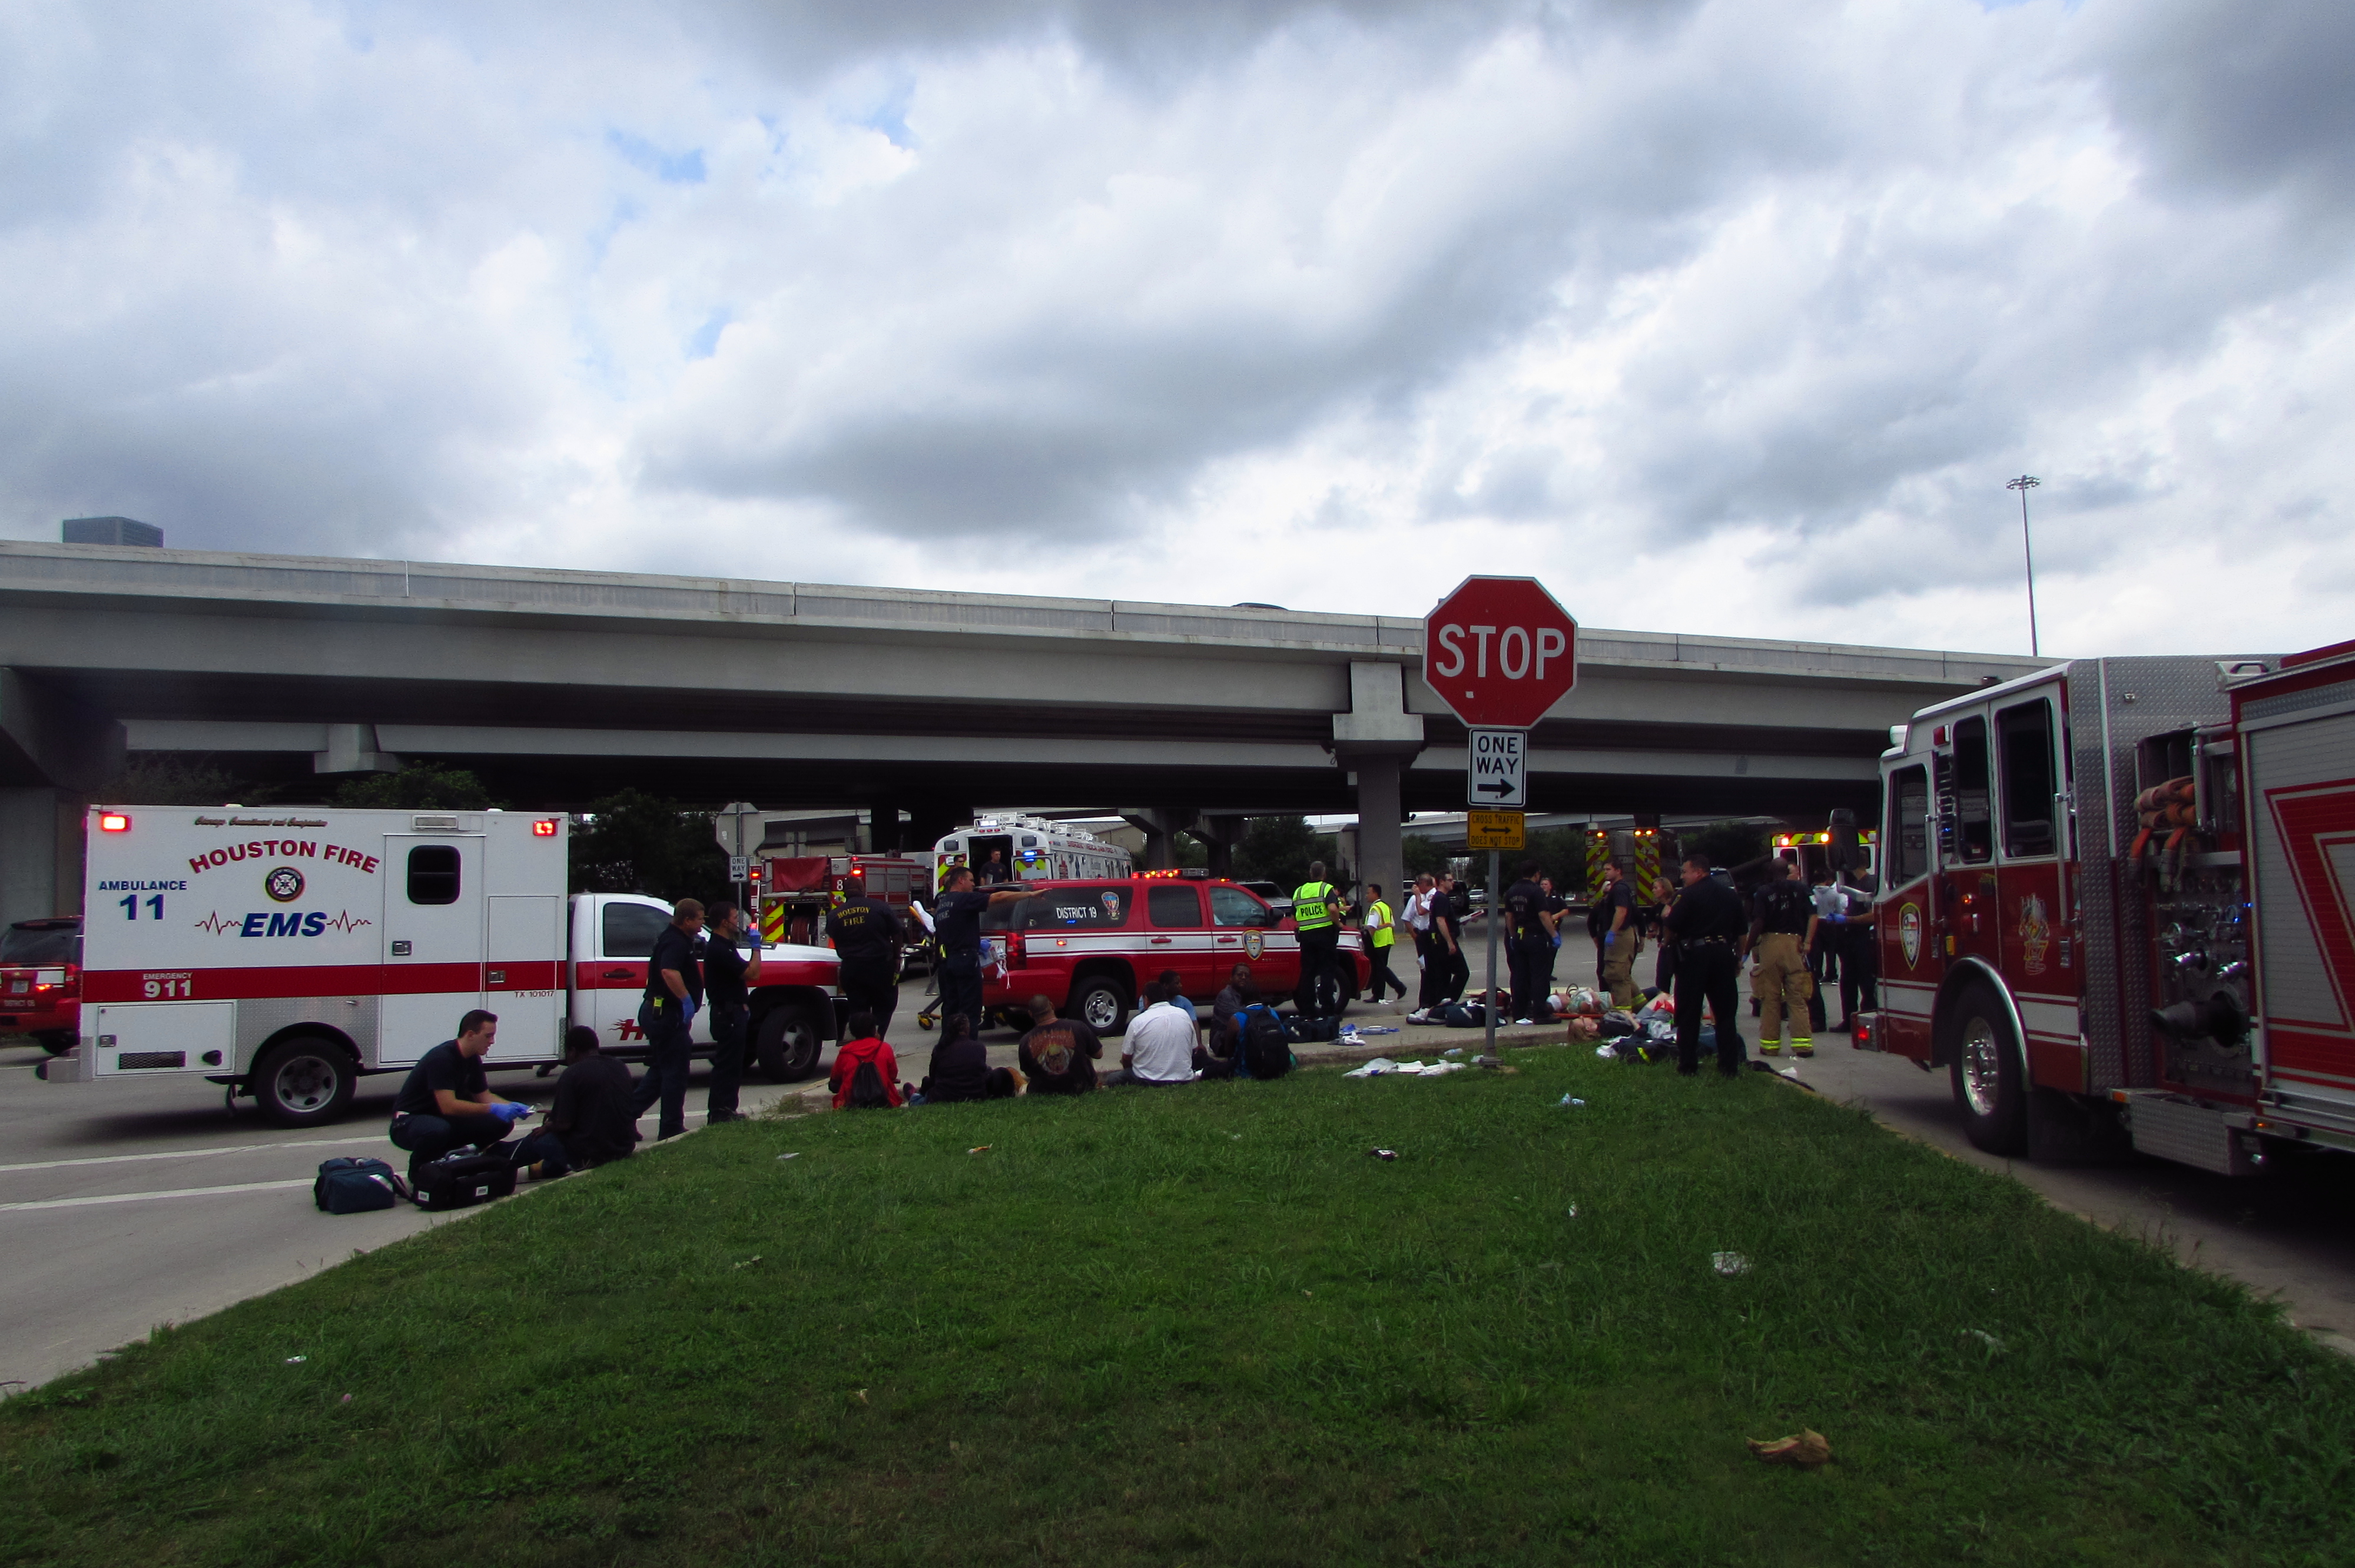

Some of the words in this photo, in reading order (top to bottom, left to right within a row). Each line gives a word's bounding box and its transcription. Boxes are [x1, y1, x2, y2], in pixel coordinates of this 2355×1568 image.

[1435, 623, 1565, 680] STOP
[1478, 735, 1518, 754] ONE
[1477, 756, 1518, 775] WAY
[1472, 815, 1492, 824] CROSS
[1495, 814, 1520, 825] TRAFFIC
[1471, 835, 1487, 845] DOES
[1489, 836, 1501, 846] NOT
[1504, 836, 1520, 846] STOP
[189, 840, 317, 873] HOUSTON
[324, 844, 380, 873] FIRE
[99, 881, 187, 891] AMBULANCE
[837, 879, 843, 891] 8
[120, 893, 165, 921] 11
[837, 906, 871, 919] HOUSTON
[1056, 907, 1087, 919] DISTRICT
[1089, 906, 1097, 918] 19
[1300, 905, 1323, 917] POLICE
[240, 912, 328, 938] EMS
[844, 915, 865, 927] FIRE
[143, 972, 193, 980] EMERGENCY
[144, 979, 192, 998] 911
